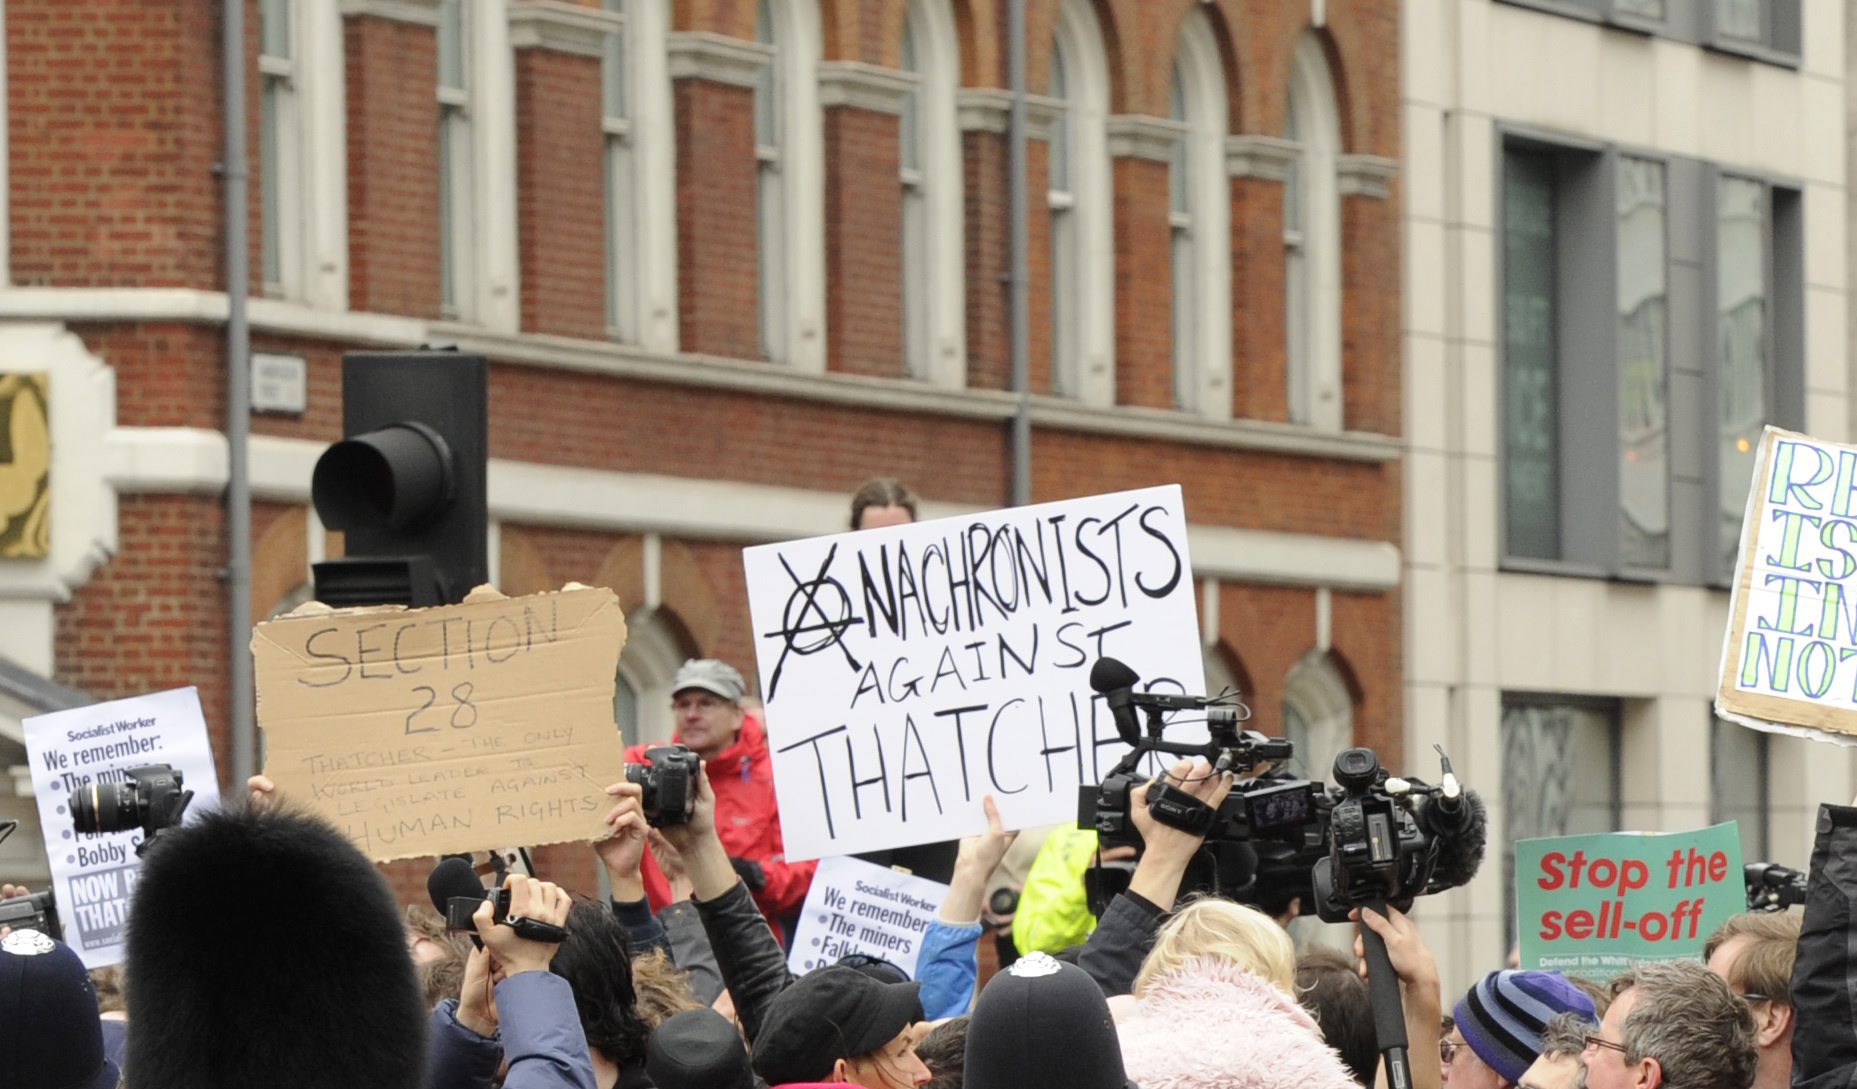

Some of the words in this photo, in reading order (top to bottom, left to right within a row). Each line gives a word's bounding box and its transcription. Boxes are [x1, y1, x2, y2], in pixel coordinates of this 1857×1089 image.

[764, 504, 1182, 703] ANACHRONISTS
[298, 600, 557, 688] SECTION
[850, 621, 1132, 708] AGAINST
[405, 682, 477, 735] 28
[67, 722, 115, 742] Socialist
[116, 717, 157, 733] Worker
[43, 750, 68, 771] We
[73, 734, 163, 764] remember:
[301, 746, 432, 775] THATCHER
[461, 736, 503, 751] THE
[523, 727, 575, 747] ONLY
[61, 771, 91, 793] The
[311, 778, 395, 802] WORLD
[407, 764, 490, 786] LEADER
[337, 787, 468, 817] LEGISLATE
[490, 761, 591, 795] AGAINST
[348, 808, 474, 852] HUMAN
[496, 795, 600, 825] RIGHTS
[78, 842, 126, 867] Bobby
[1537, 851, 1649, 897] Stop
[1667, 848, 1728, 889] the
[71, 872, 118, 905] NOW
[823, 886, 846, 910] We
[855, 880, 899, 903] Socialist
[900, 893, 937, 912] Worker
[828, 913, 855, 937] The
[859, 926, 912, 954] miners
[1539, 898, 1705, 942] sell-off
[1539, 956, 1579, 968] Defend
[1581, 955, 1598, 967] the
